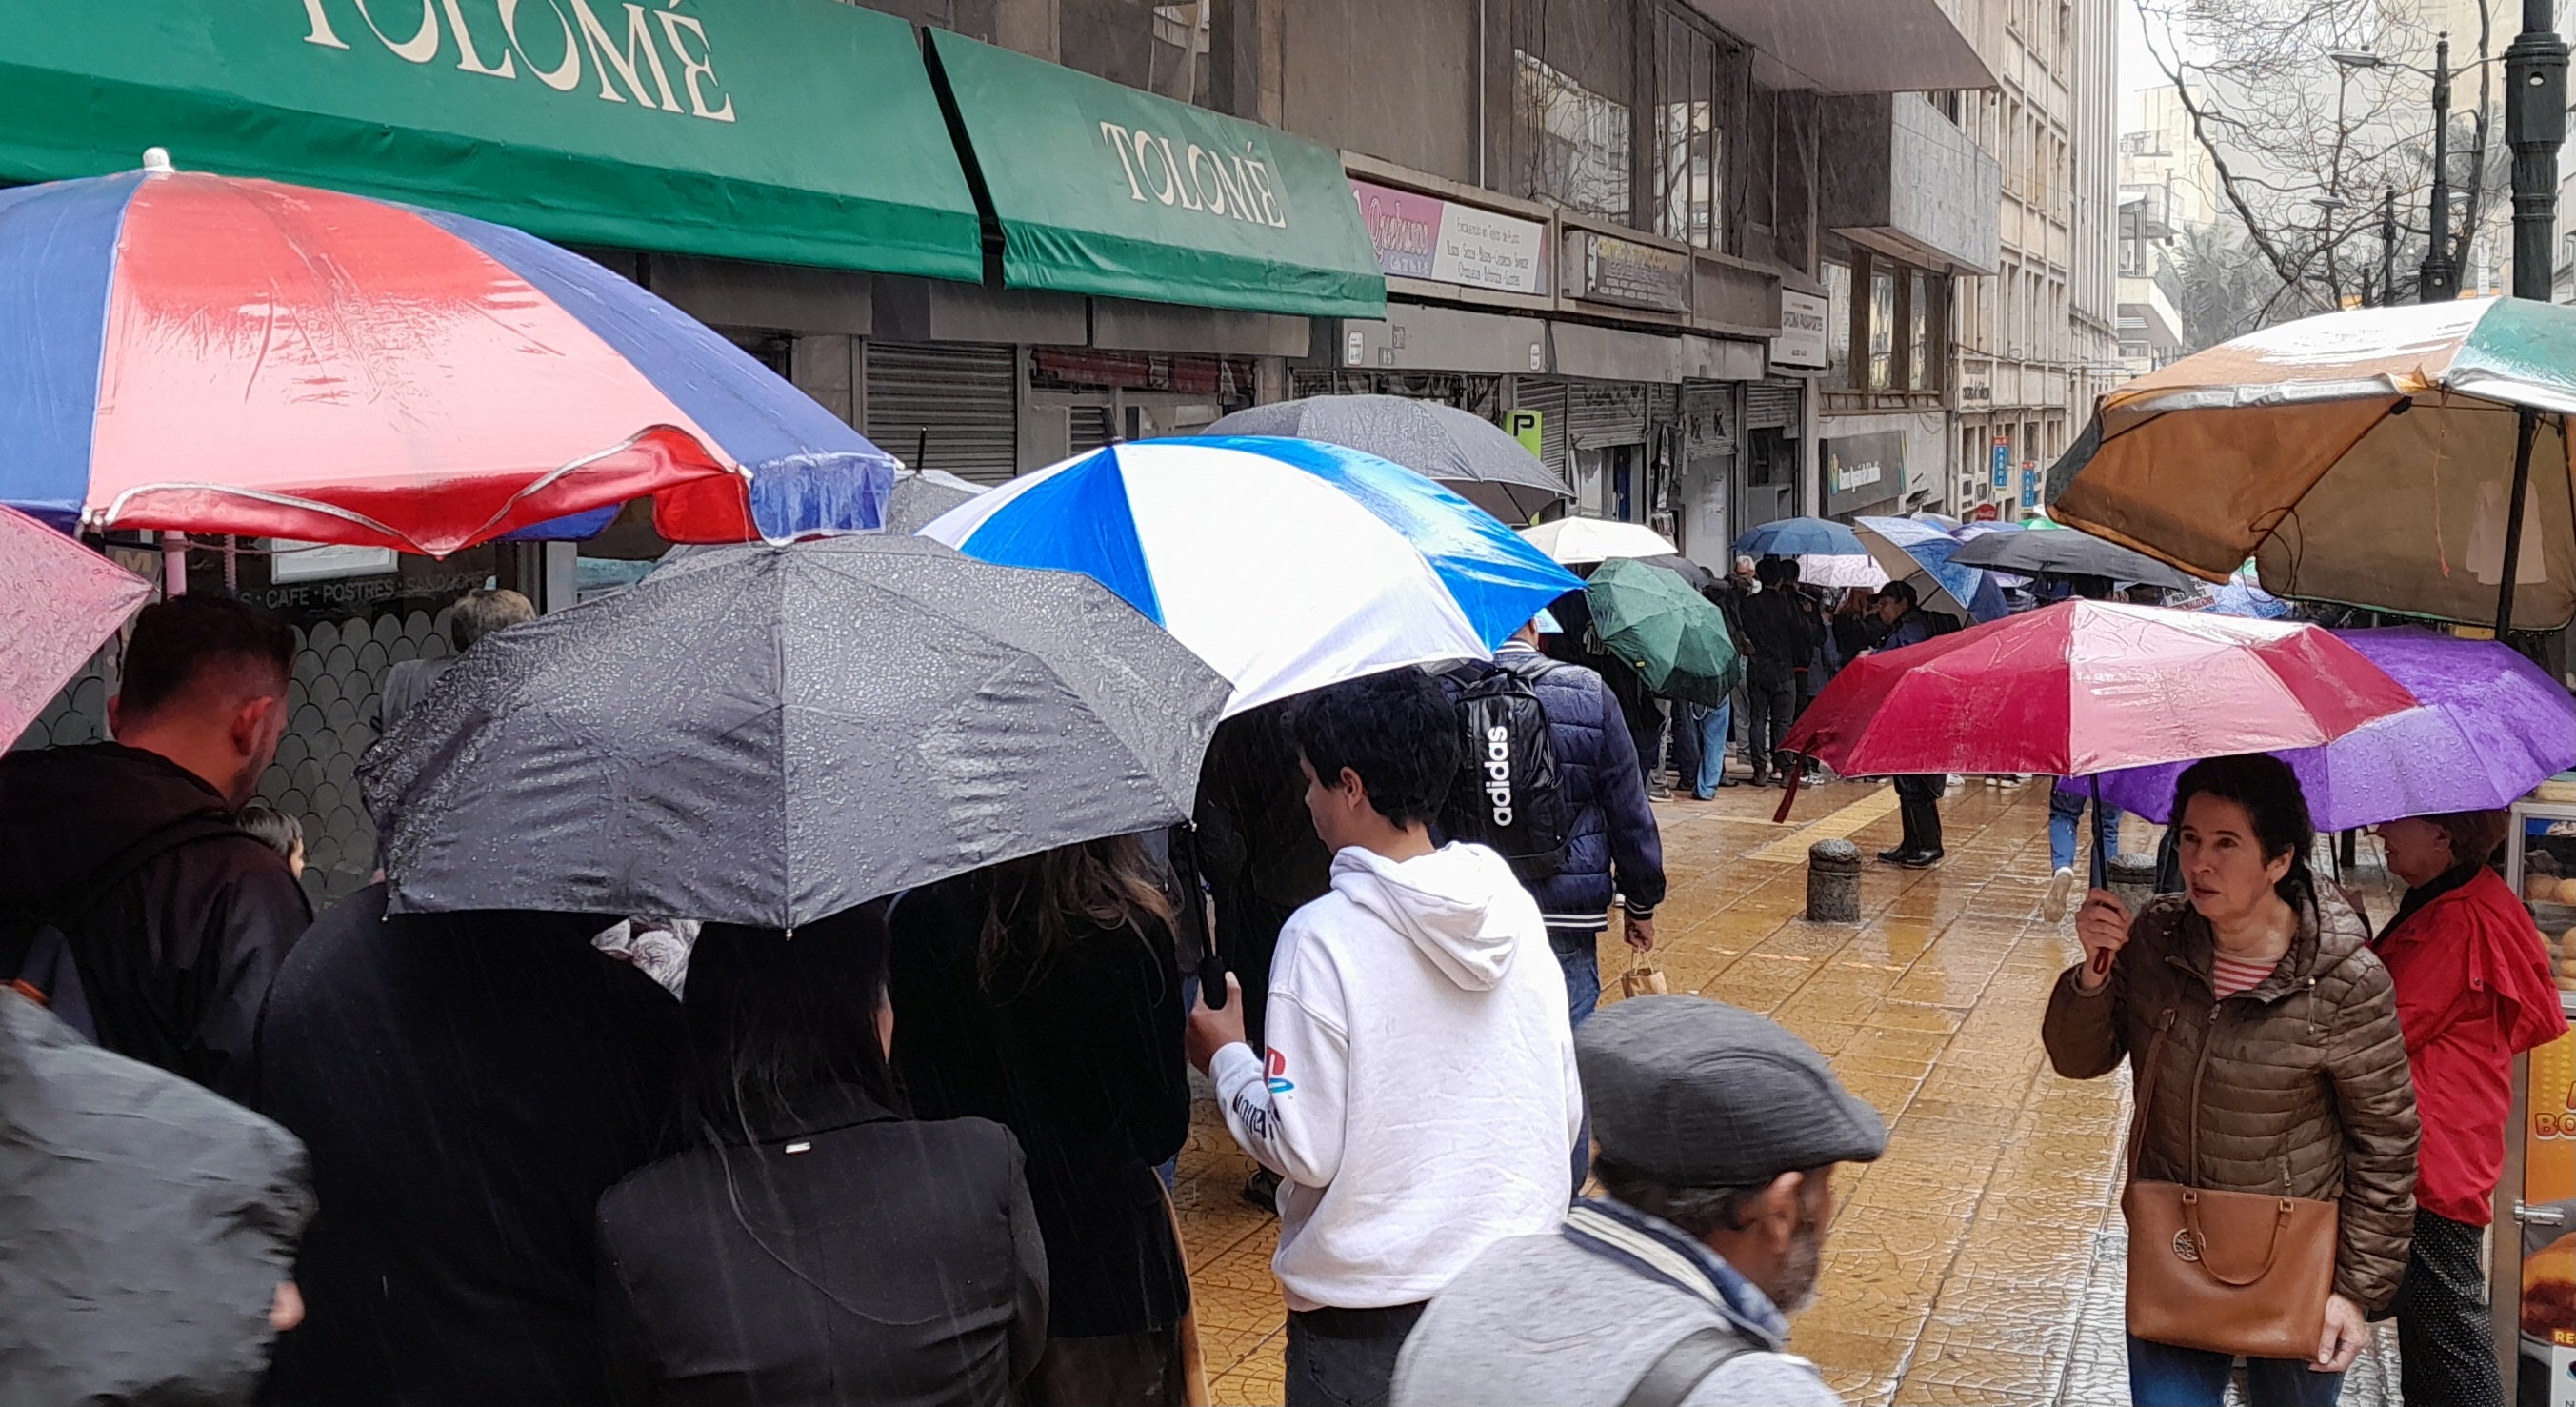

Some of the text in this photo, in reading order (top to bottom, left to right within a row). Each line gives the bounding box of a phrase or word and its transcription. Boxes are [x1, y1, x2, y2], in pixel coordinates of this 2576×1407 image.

[1100, 121, 1286, 228] TOLOMÉ
[1513, 414, 1535, 436] P
[323, 578, 395, 602] POSTRES
[1484, 726, 1513, 826] adidas
